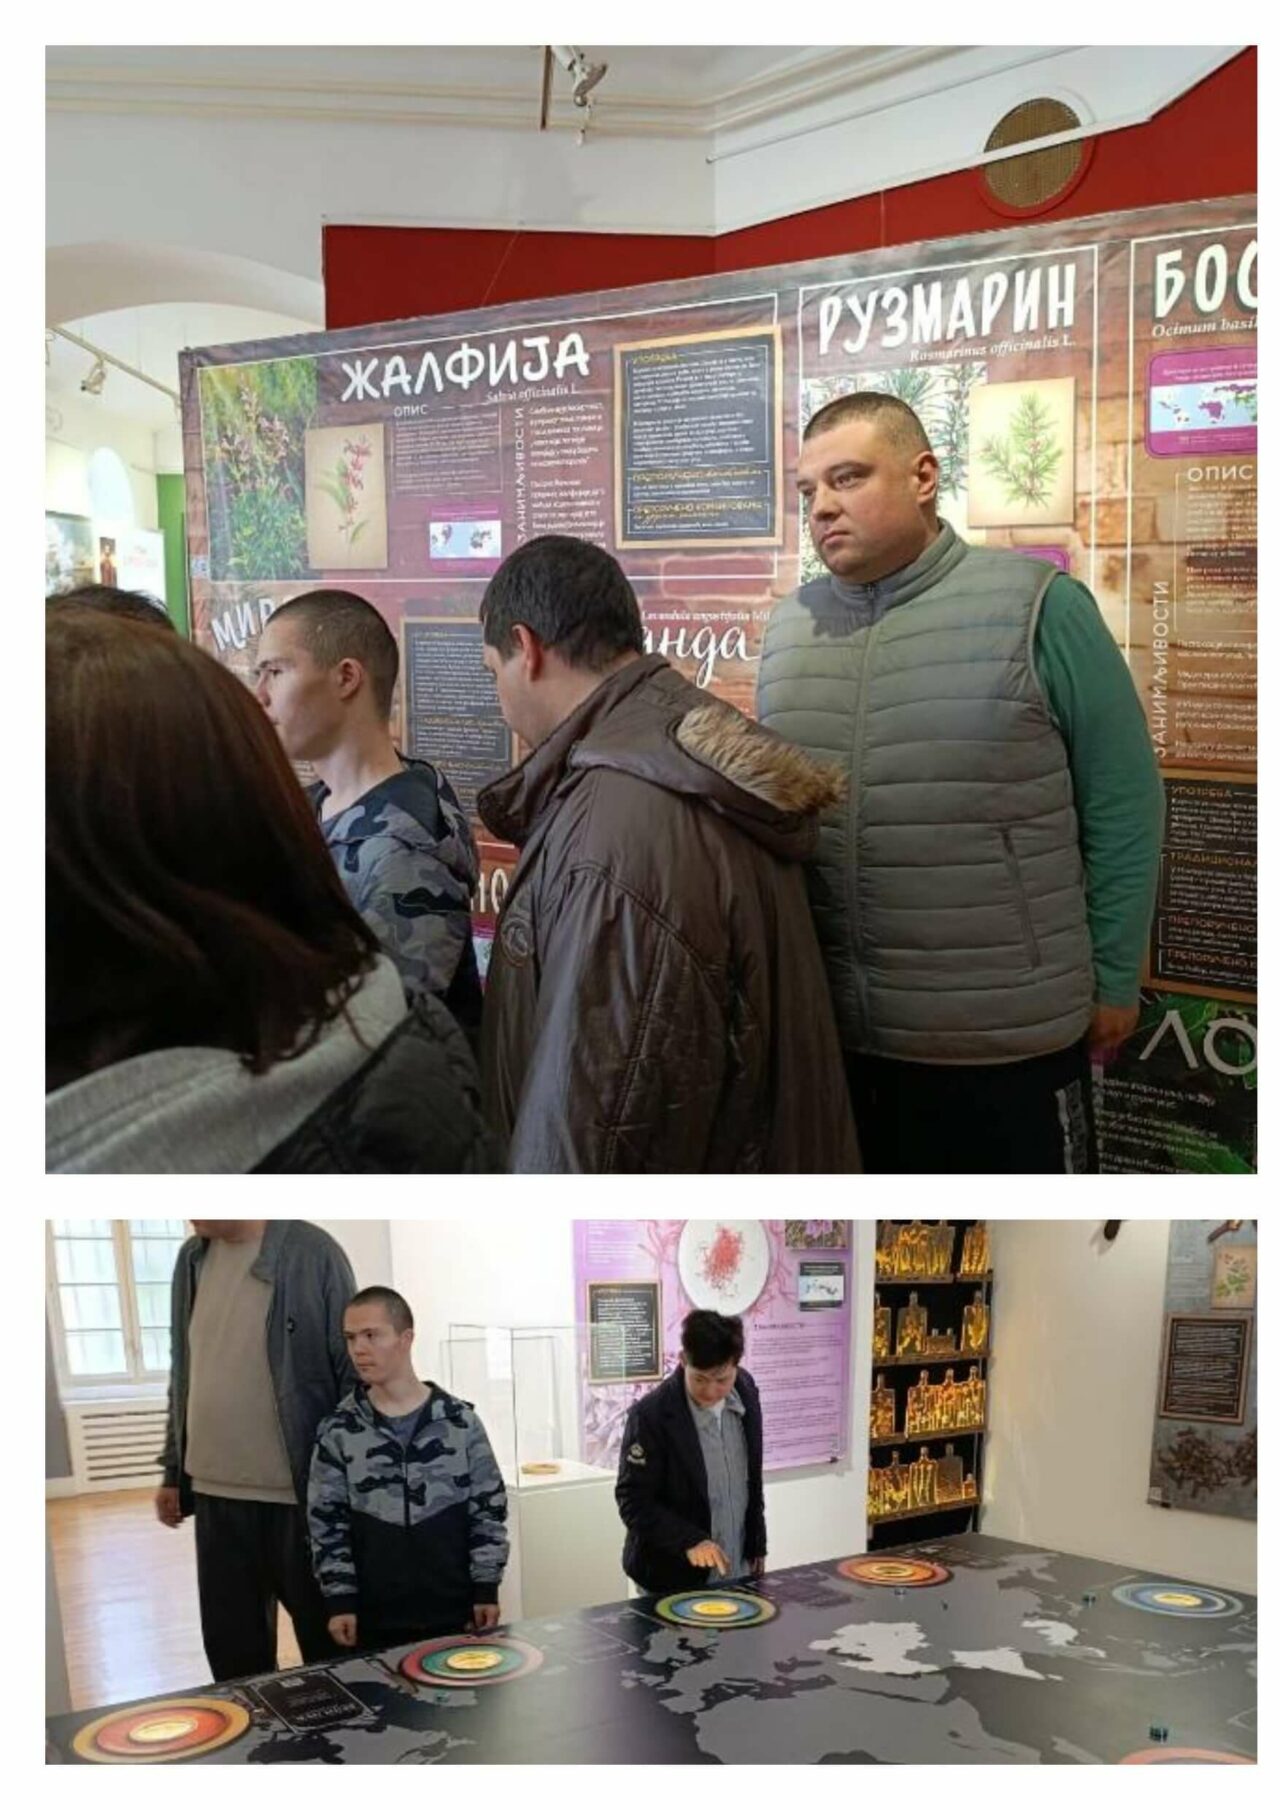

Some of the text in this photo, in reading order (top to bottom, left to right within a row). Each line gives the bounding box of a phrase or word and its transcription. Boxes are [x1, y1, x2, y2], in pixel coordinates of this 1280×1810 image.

[819, 263, 1076, 354] РУЗМАРИН
[1152, 315, 1257, 338] Ocimum basi
[909, 345, 987, 363] Rosmarinus
[990, 335, 1060, 359] officinalis
[341, 332, 591, 402] ЖАЛФИЈА
[394, 404, 429, 418] ОПИС
[1187, 465, 1254, 482] ОПИС
[1153, 581, 1169, 758] ЗАНИМЉИВОСТИ
